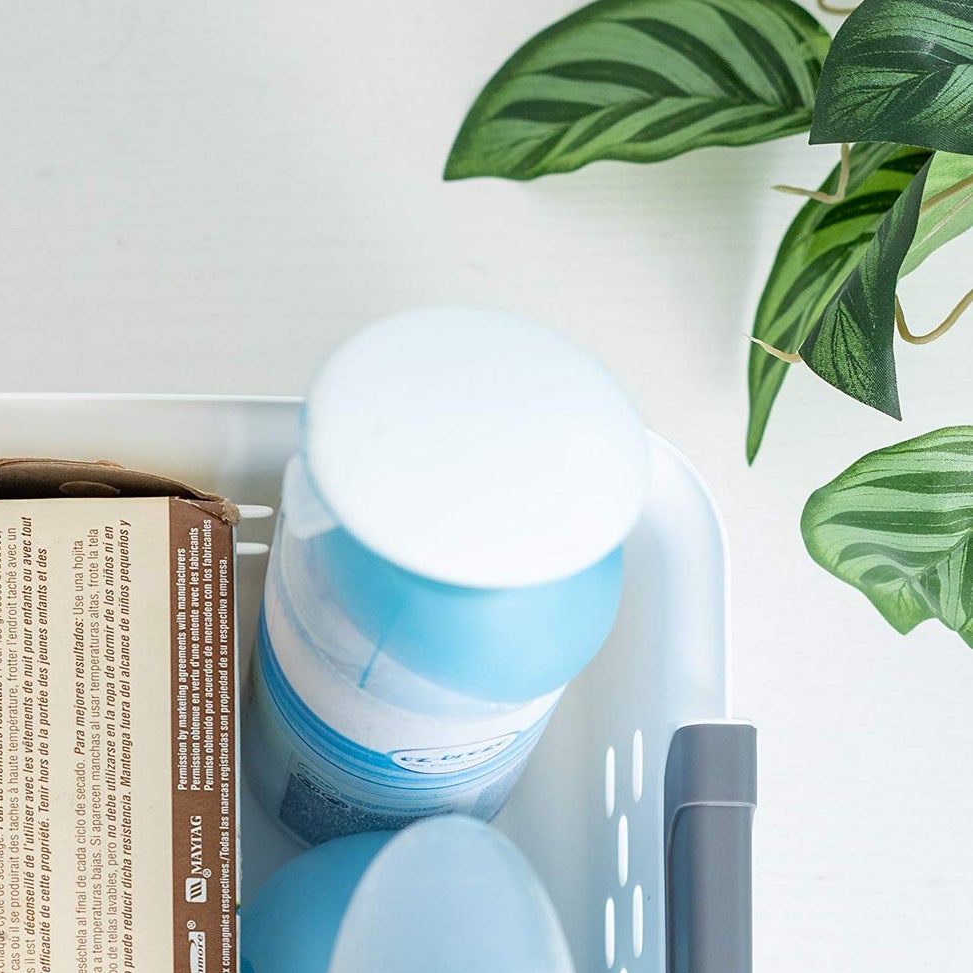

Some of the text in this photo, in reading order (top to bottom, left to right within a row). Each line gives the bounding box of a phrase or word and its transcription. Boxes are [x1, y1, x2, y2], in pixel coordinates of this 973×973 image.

[189, 528, 199, 570] fabricants
[189, 572, 199, 584] les
[219, 557, 229, 596] empresa.
[191, 587, 199, 607] avec
[190, 610, 199, 641] entente
[218, 599, 230, 642] respectiva
[202, 519, 215, 790] Permiso obtenido por acuerdos de mercadeo con los fabricantes
[218, 657, 228, 668] de
[220, 645, 228, 655] su
[176, 548, 189, 790] Permission by marketing agreements with manufacturers
[190, 670, 200, 691] vertu
[192, 693, 200, 703] en
[218, 670, 230, 713] propiedad
[190, 706, 200, 740] obtenue
[220, 715, 228, 730] son
[190, 743, 200, 790] Permission
[219, 733, 230, 780] registradas
[221, 783, 229, 814] marcas
[219, 817, 229, 829] las
[220, 915, 232, 966] compagnies
